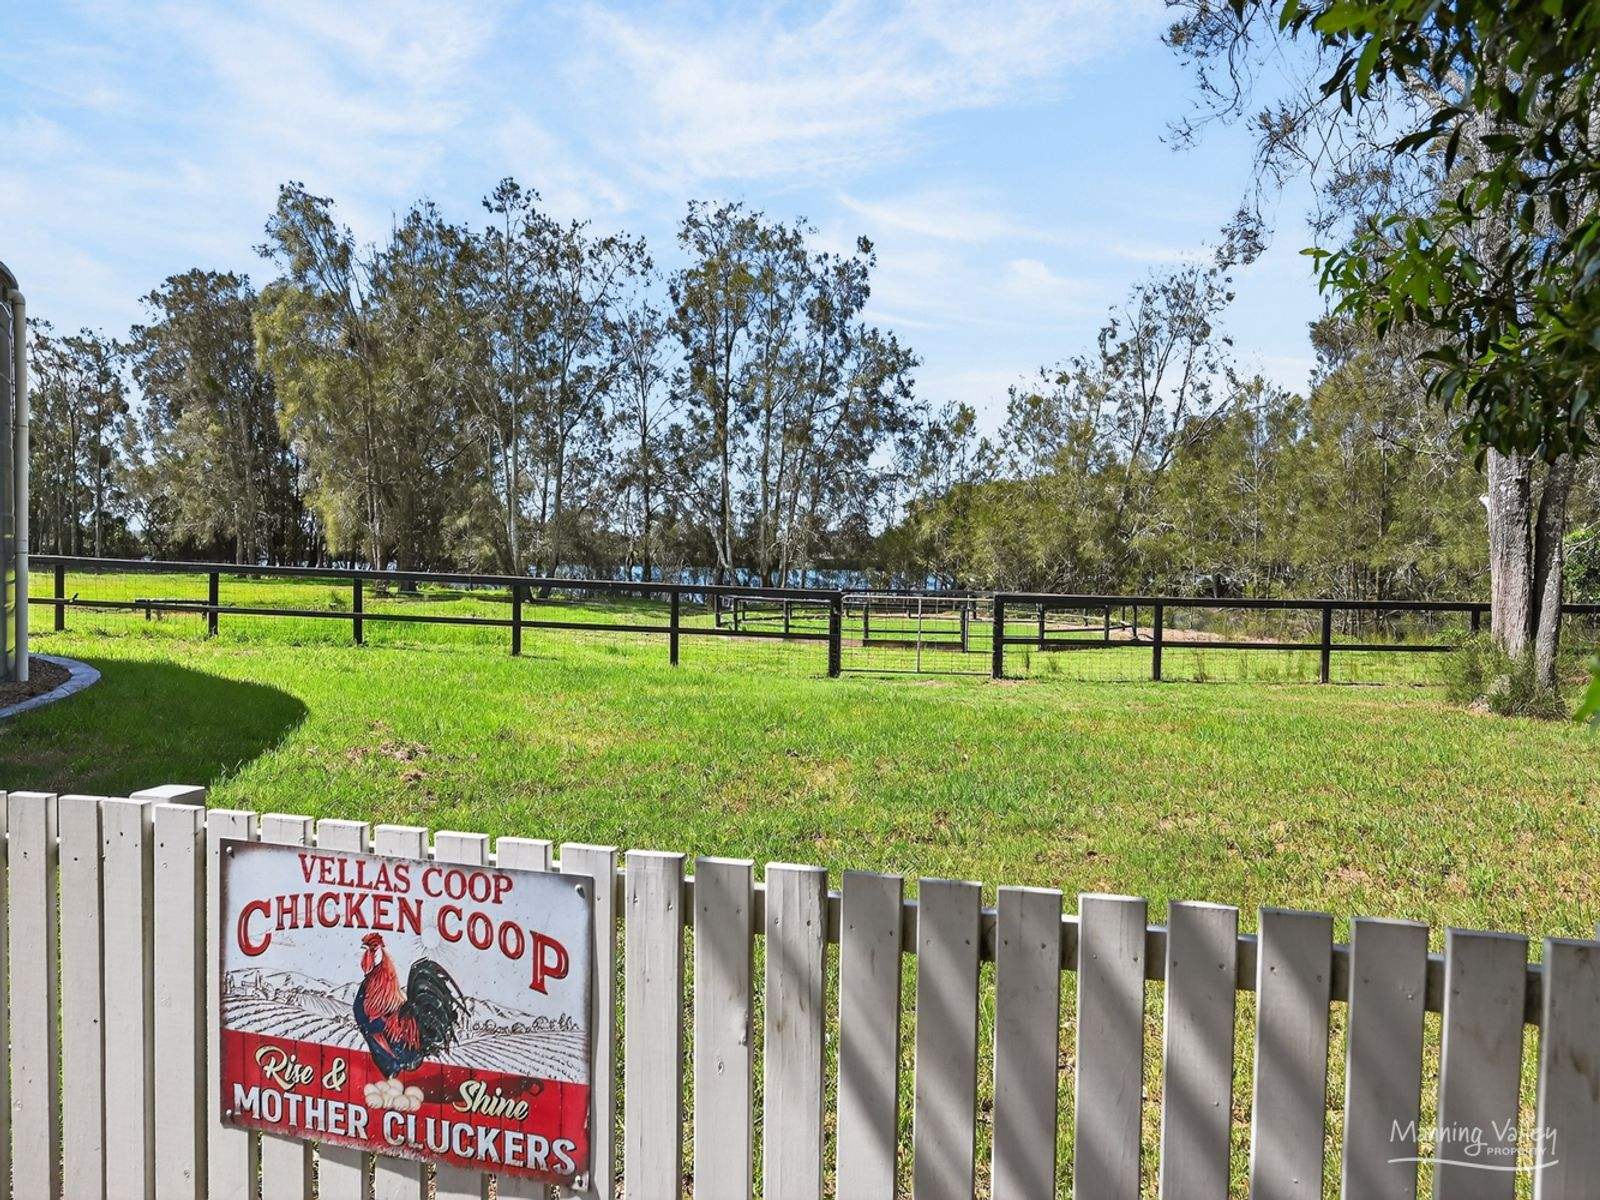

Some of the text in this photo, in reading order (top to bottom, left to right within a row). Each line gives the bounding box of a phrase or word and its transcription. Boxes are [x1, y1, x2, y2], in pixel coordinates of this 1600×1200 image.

[298, 853, 514, 905] VELLAS COOP
[238, 891, 569, 995] CHICKEN COOP
[255, 1045, 529, 1121] Rise & Shine
[233, 1083, 577, 1175] MOTHER CLUCKERS
